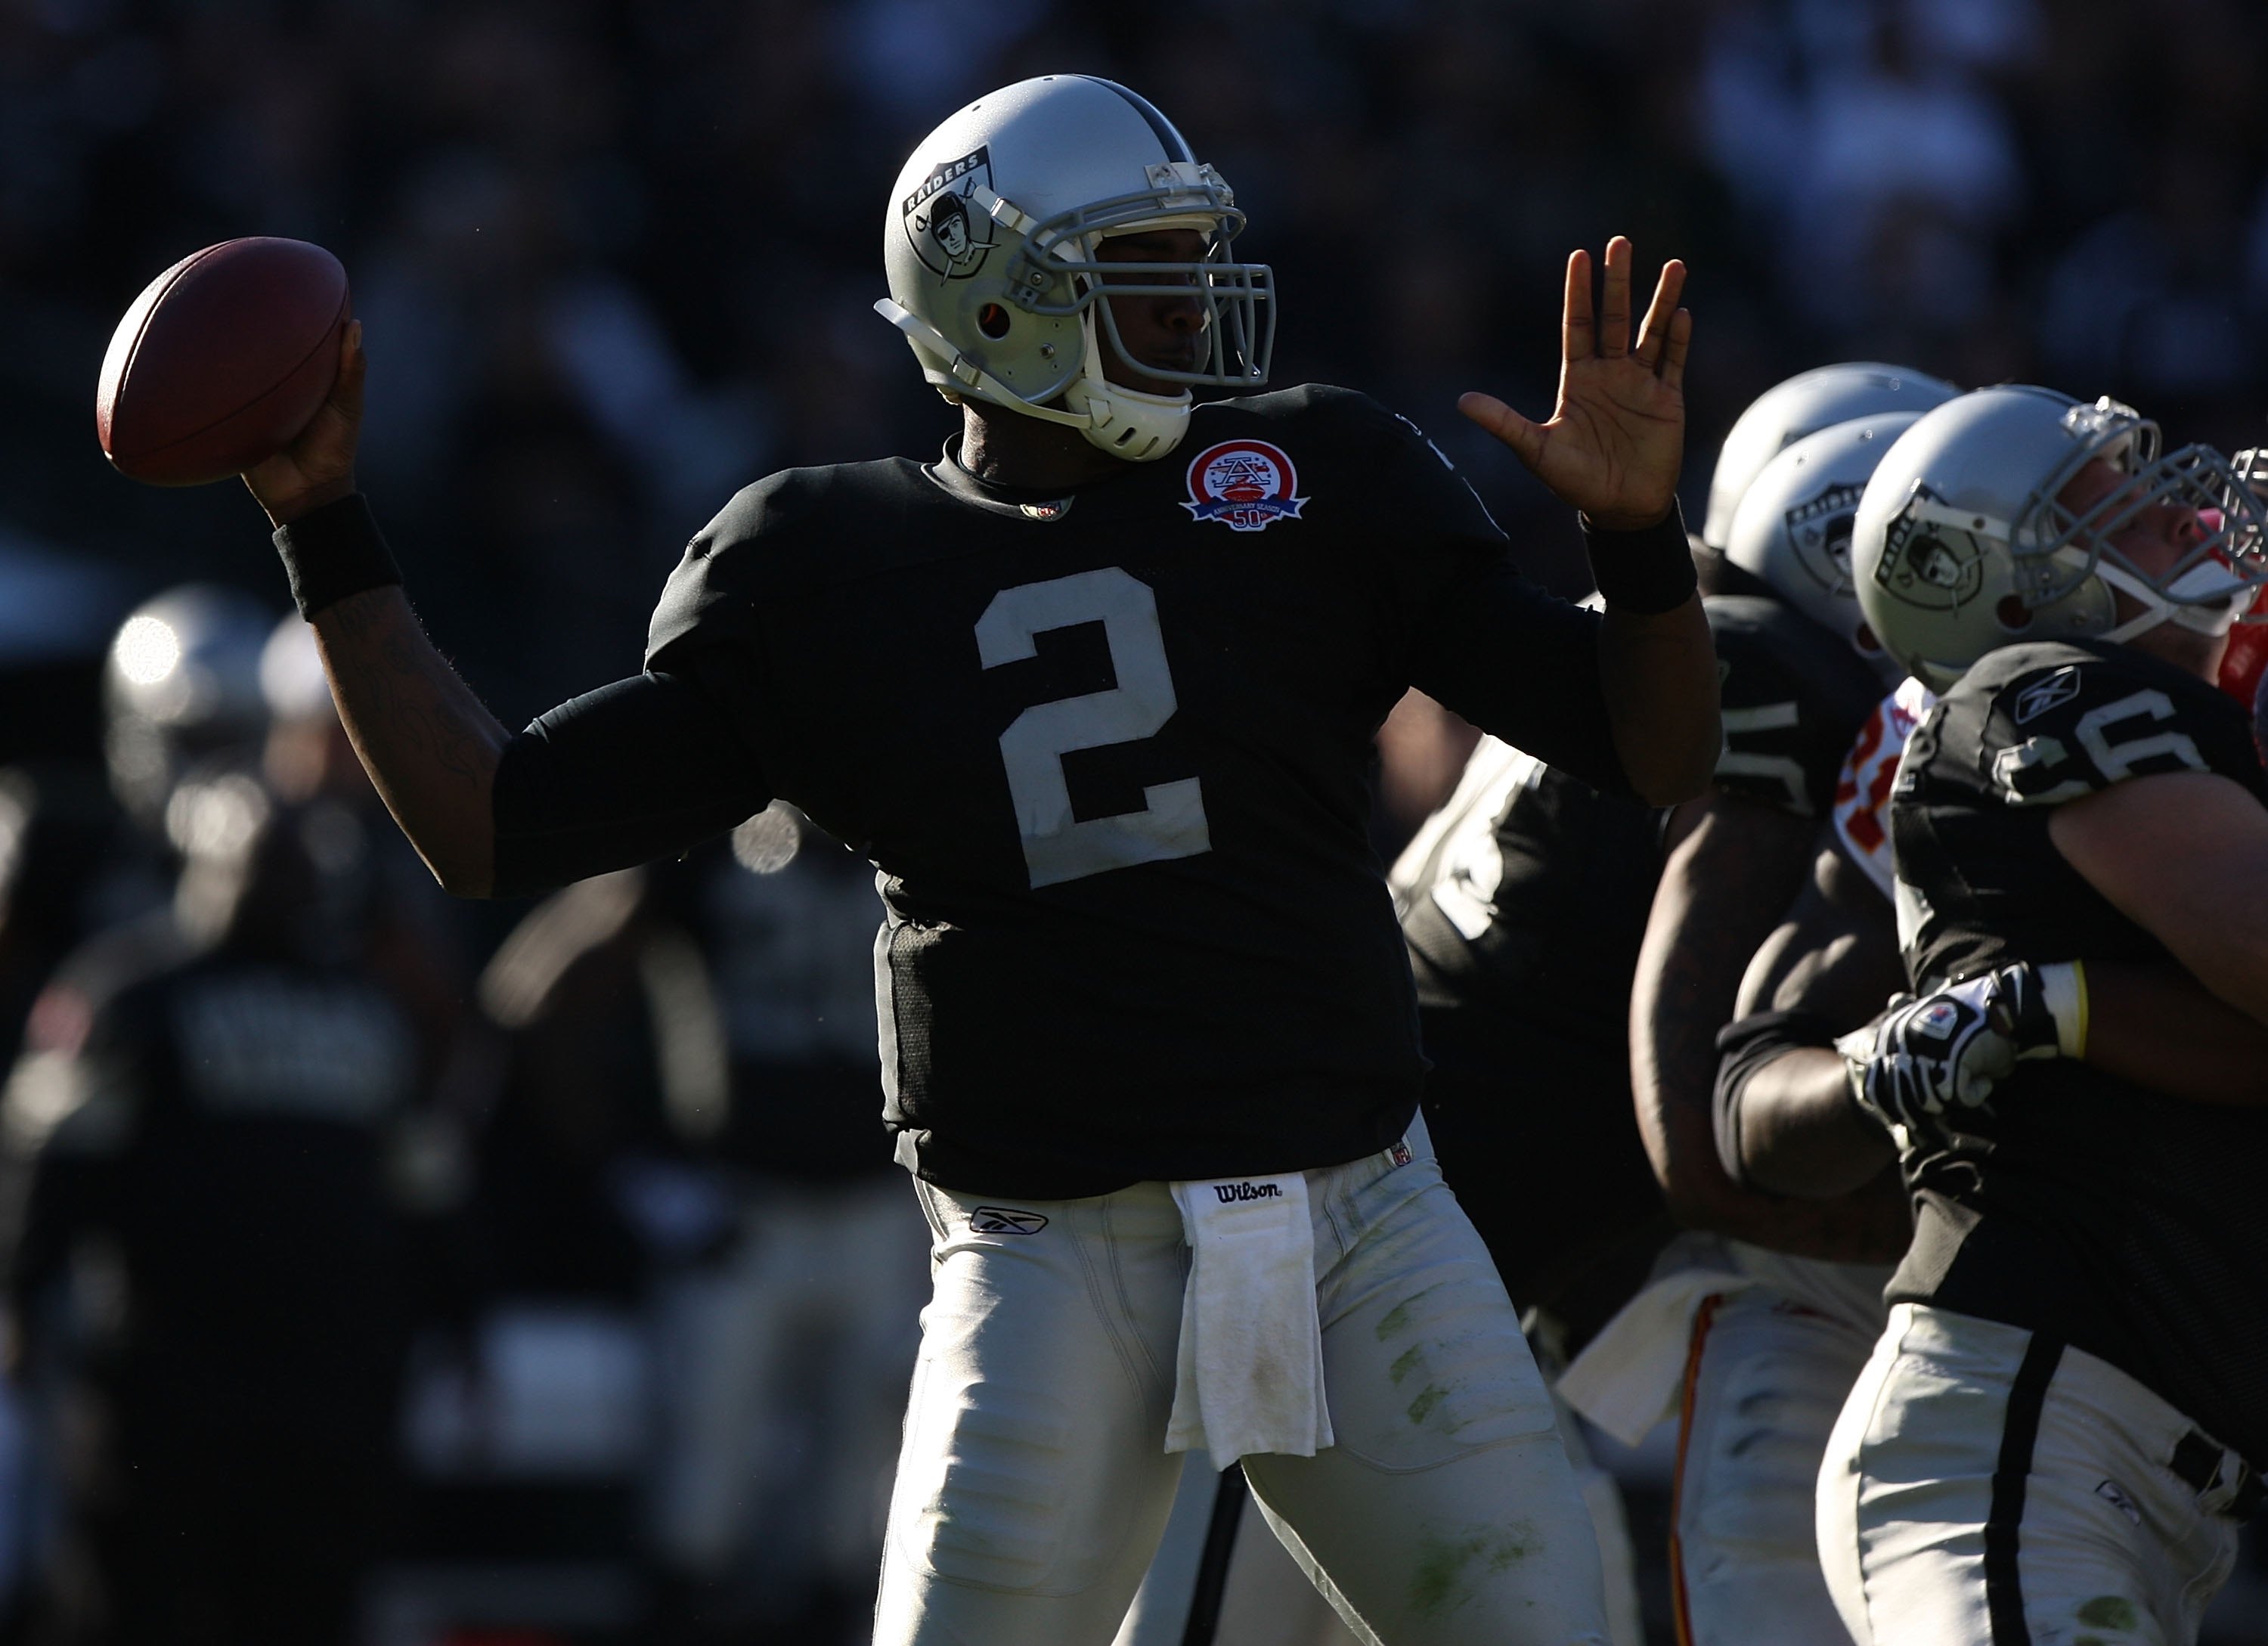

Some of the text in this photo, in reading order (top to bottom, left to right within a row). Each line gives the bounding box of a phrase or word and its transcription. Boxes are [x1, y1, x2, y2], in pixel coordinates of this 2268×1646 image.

[906, 153, 979, 212] RAIDERS
[973, 565, 1214, 891] 2
[1213, 1182, 1280, 1204] Wilson
